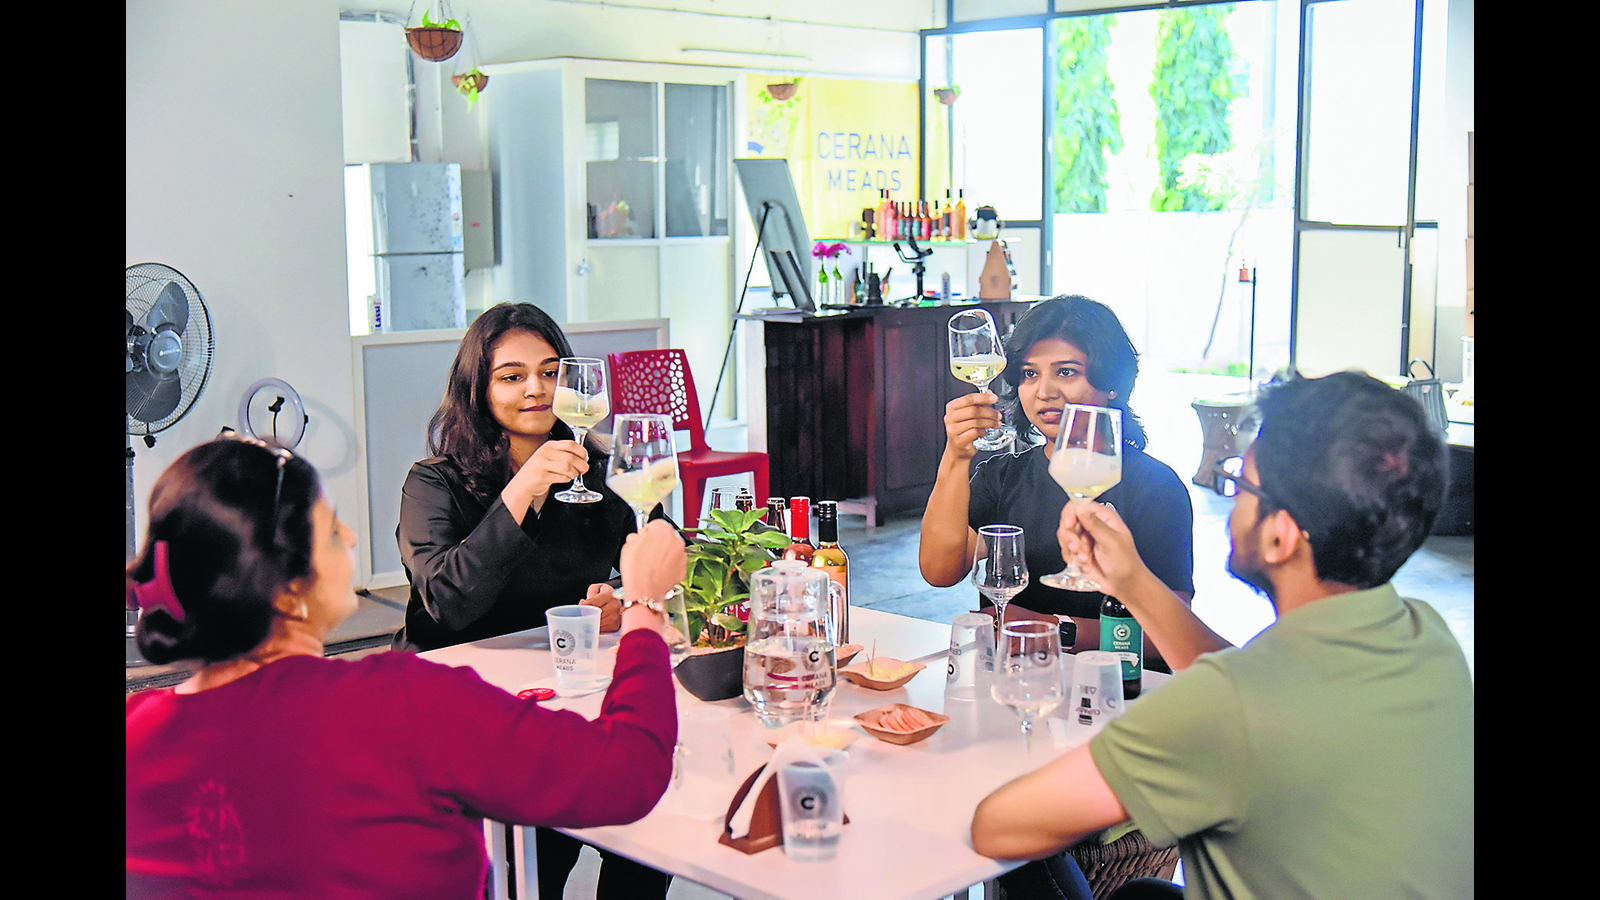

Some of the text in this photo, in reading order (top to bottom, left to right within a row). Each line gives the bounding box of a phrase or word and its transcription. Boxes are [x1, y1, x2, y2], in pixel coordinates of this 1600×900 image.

[818, 132, 912, 159] CERANA
[828, 170, 901, 191] MEADS
[556, 637, 566, 649] C
[809, 651, 819, 662] C
[801, 797, 814, 810] C
